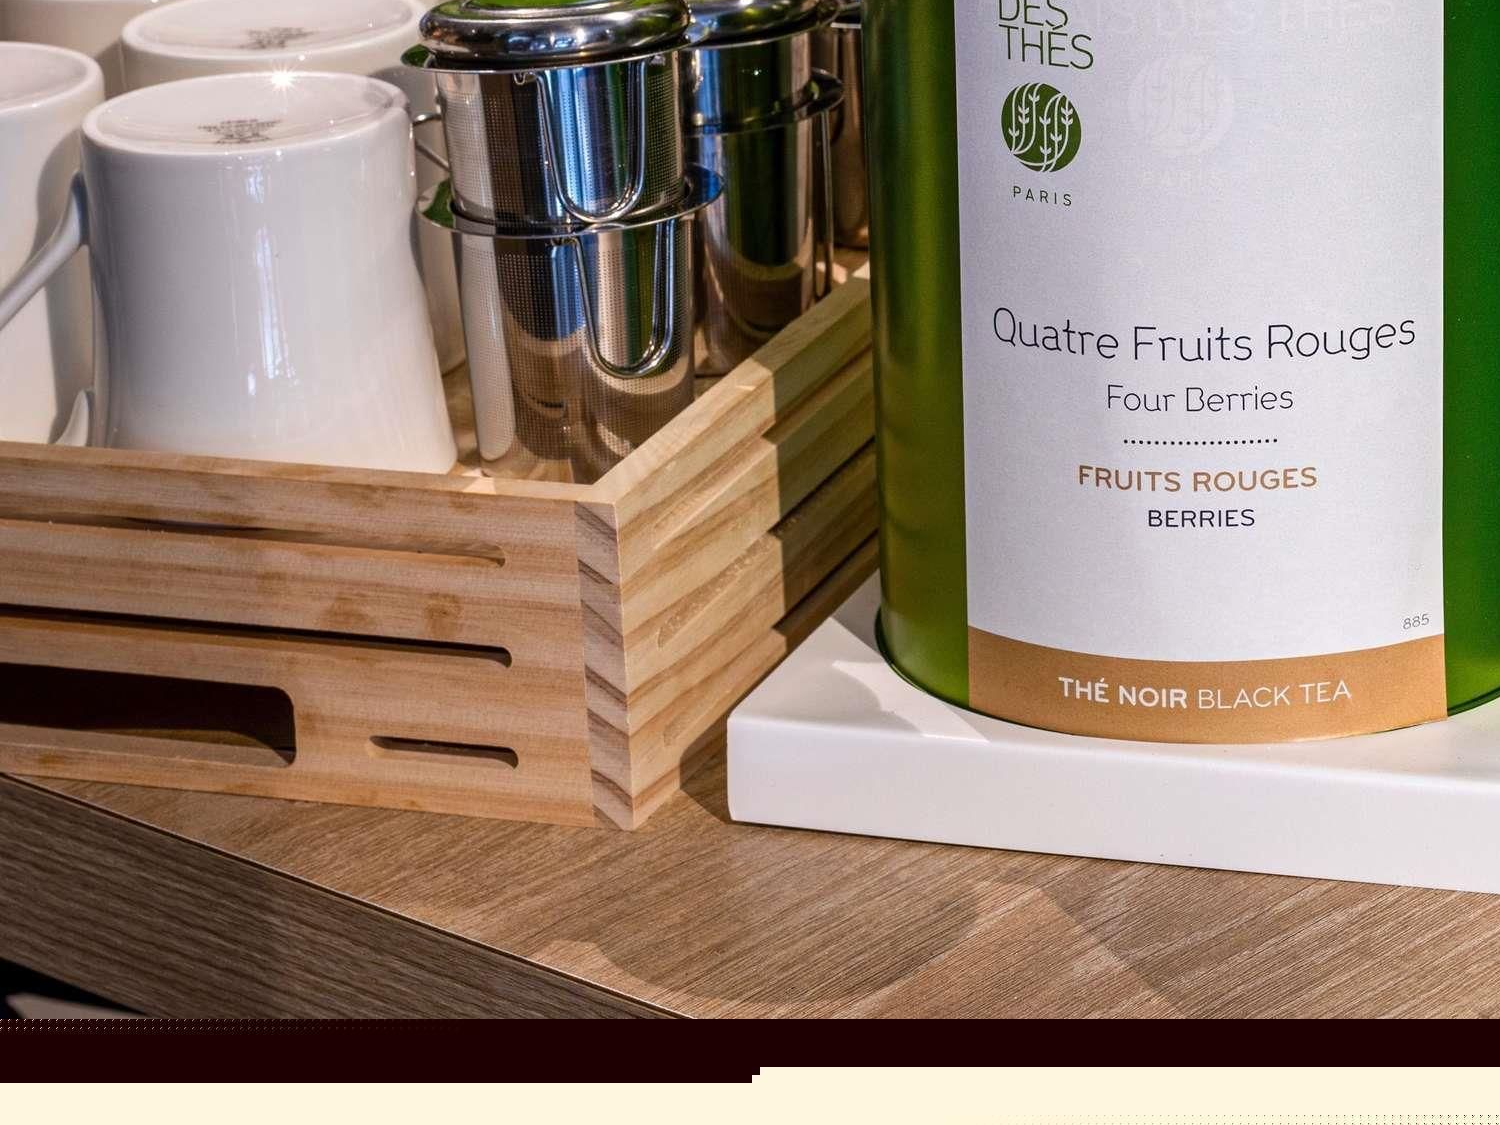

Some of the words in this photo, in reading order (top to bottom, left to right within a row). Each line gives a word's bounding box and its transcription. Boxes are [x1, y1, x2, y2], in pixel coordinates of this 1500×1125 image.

[998, 23, 1094, 70] THÉS
[1013, 185, 1073, 207] PARIS
[994, 307, 1119, 361] Quatre
[1133, 324, 1253, 363] Fruits
[1267, 318, 1416, 362] Rouges
[1107, 385, 1175, 412] Four
[1186, 386, 1293, 412] Berries
[1079, 465, 1181, 492] FRUITS
[1193, 466, 1318, 492] ROUGES
[1147, 509, 1256, 528] BERRIES
[1402, 613, 1431, 630] 885
[1058, 676, 1109, 704] THÉ
[1119, 685, 1188, 709] NOIR
[1199, 684, 1291, 710] BLACK
[1299, 680, 1352, 703] TEA
